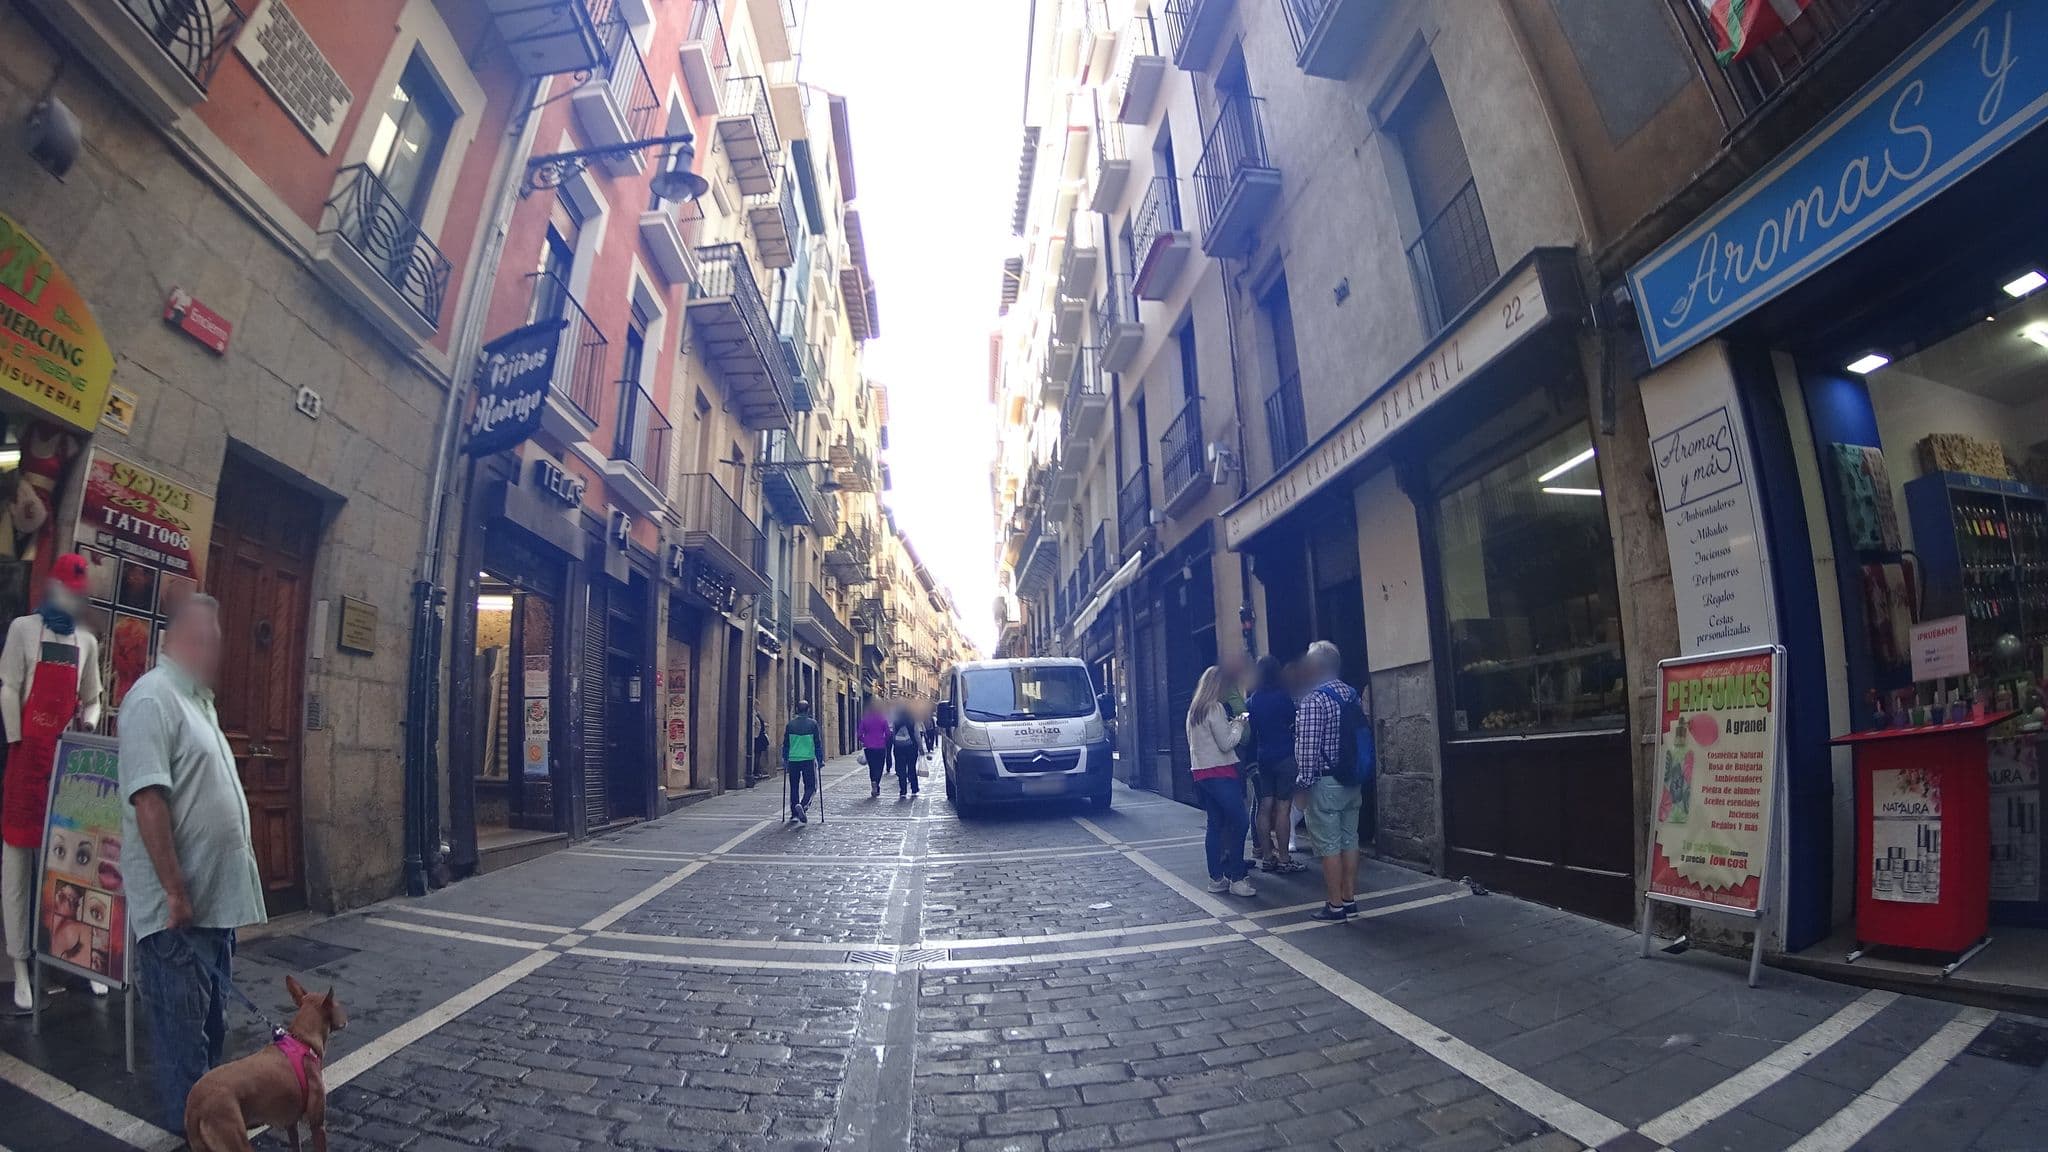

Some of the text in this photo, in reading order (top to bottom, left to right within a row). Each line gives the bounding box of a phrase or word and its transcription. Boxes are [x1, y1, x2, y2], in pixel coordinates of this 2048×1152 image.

[0, 359, 81, 413] ISUTERIA
[1306, 419, 1368, 485] CASERAS
[1381, 339, 1465, 430] BEATRIZ
[1502, 295, 1525, 330] 22
[543, 461, 587, 507] TELAS
[1677, 498, 1736, 526] Ambientadores
[102, 505, 191, 550] TATTOOS
[1690, 523, 1729, 544] Mikados
[1703, 590, 1735, 607] Regalos
[1708, 613, 1734, 628] Cestas
[1696, 625, 1751, 647] personalizadas
[1667, 671, 1770, 712] PERFUMES
[1014, 726, 1061, 736] zabaiza
[1725, 716, 1767, 735] A granel
[1739, 750, 1764, 760] Natural
[1714, 774, 1763, 784] Ambientadores
[1685, 855, 1706, 865] precio
[1709, 854, 1726, 867] low
[1727, 857, 1748, 870] cost
